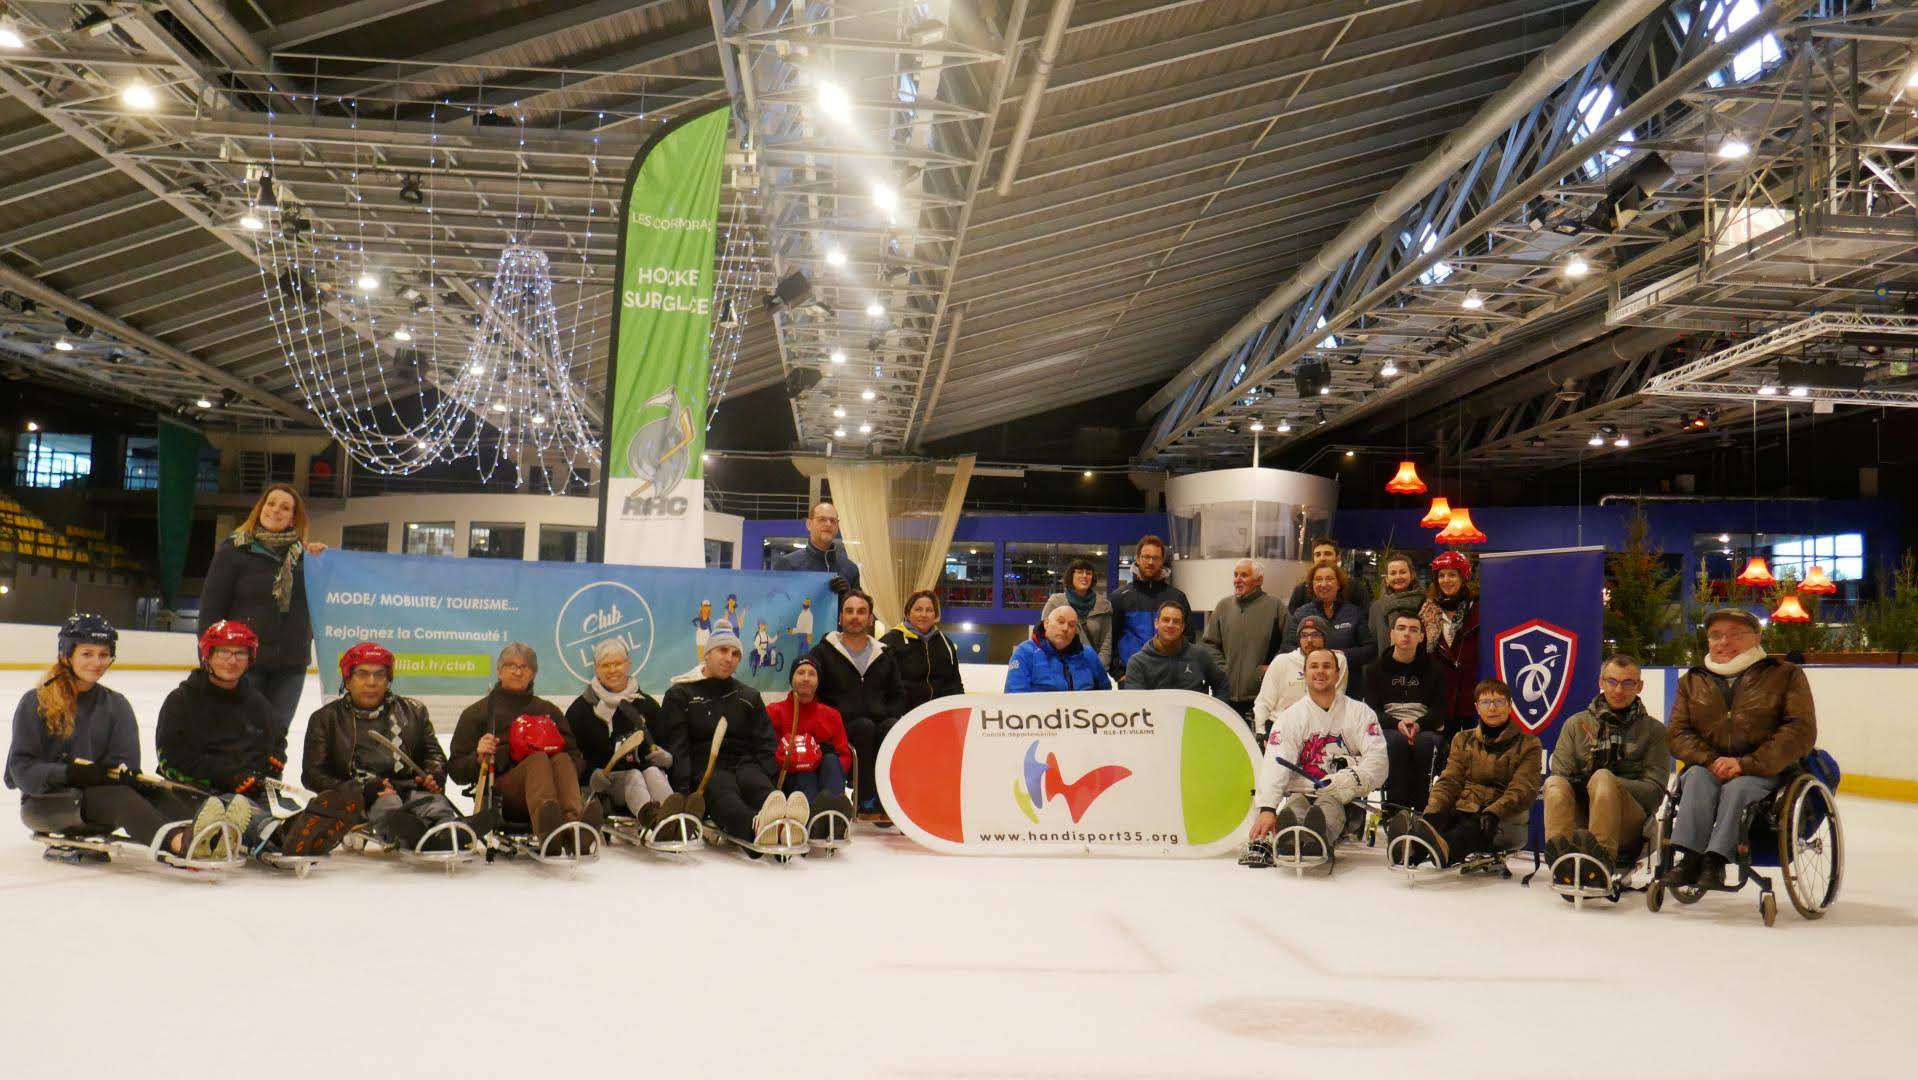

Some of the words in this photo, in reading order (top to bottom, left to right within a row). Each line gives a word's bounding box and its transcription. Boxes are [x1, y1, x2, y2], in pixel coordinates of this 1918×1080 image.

[632, 211, 652, 227] LES
[638, 266, 700, 288] HOCKE
[325, 592, 377, 605] MODE/
[380, 593, 444, 609] MOBILITE/
[446, 597, 520, 612] TOURISME...
[583, 603, 624, 634] Club
[325, 625, 394, 641] Rejoignez
[398, 627, 410, 640] la
[414, 627, 500, 642] Communauté
[394, 658, 476, 673] lilial.fr/club
[981, 708, 1154, 734] HandiSport
[980, 831, 1178, 844] www.handisport35.org
